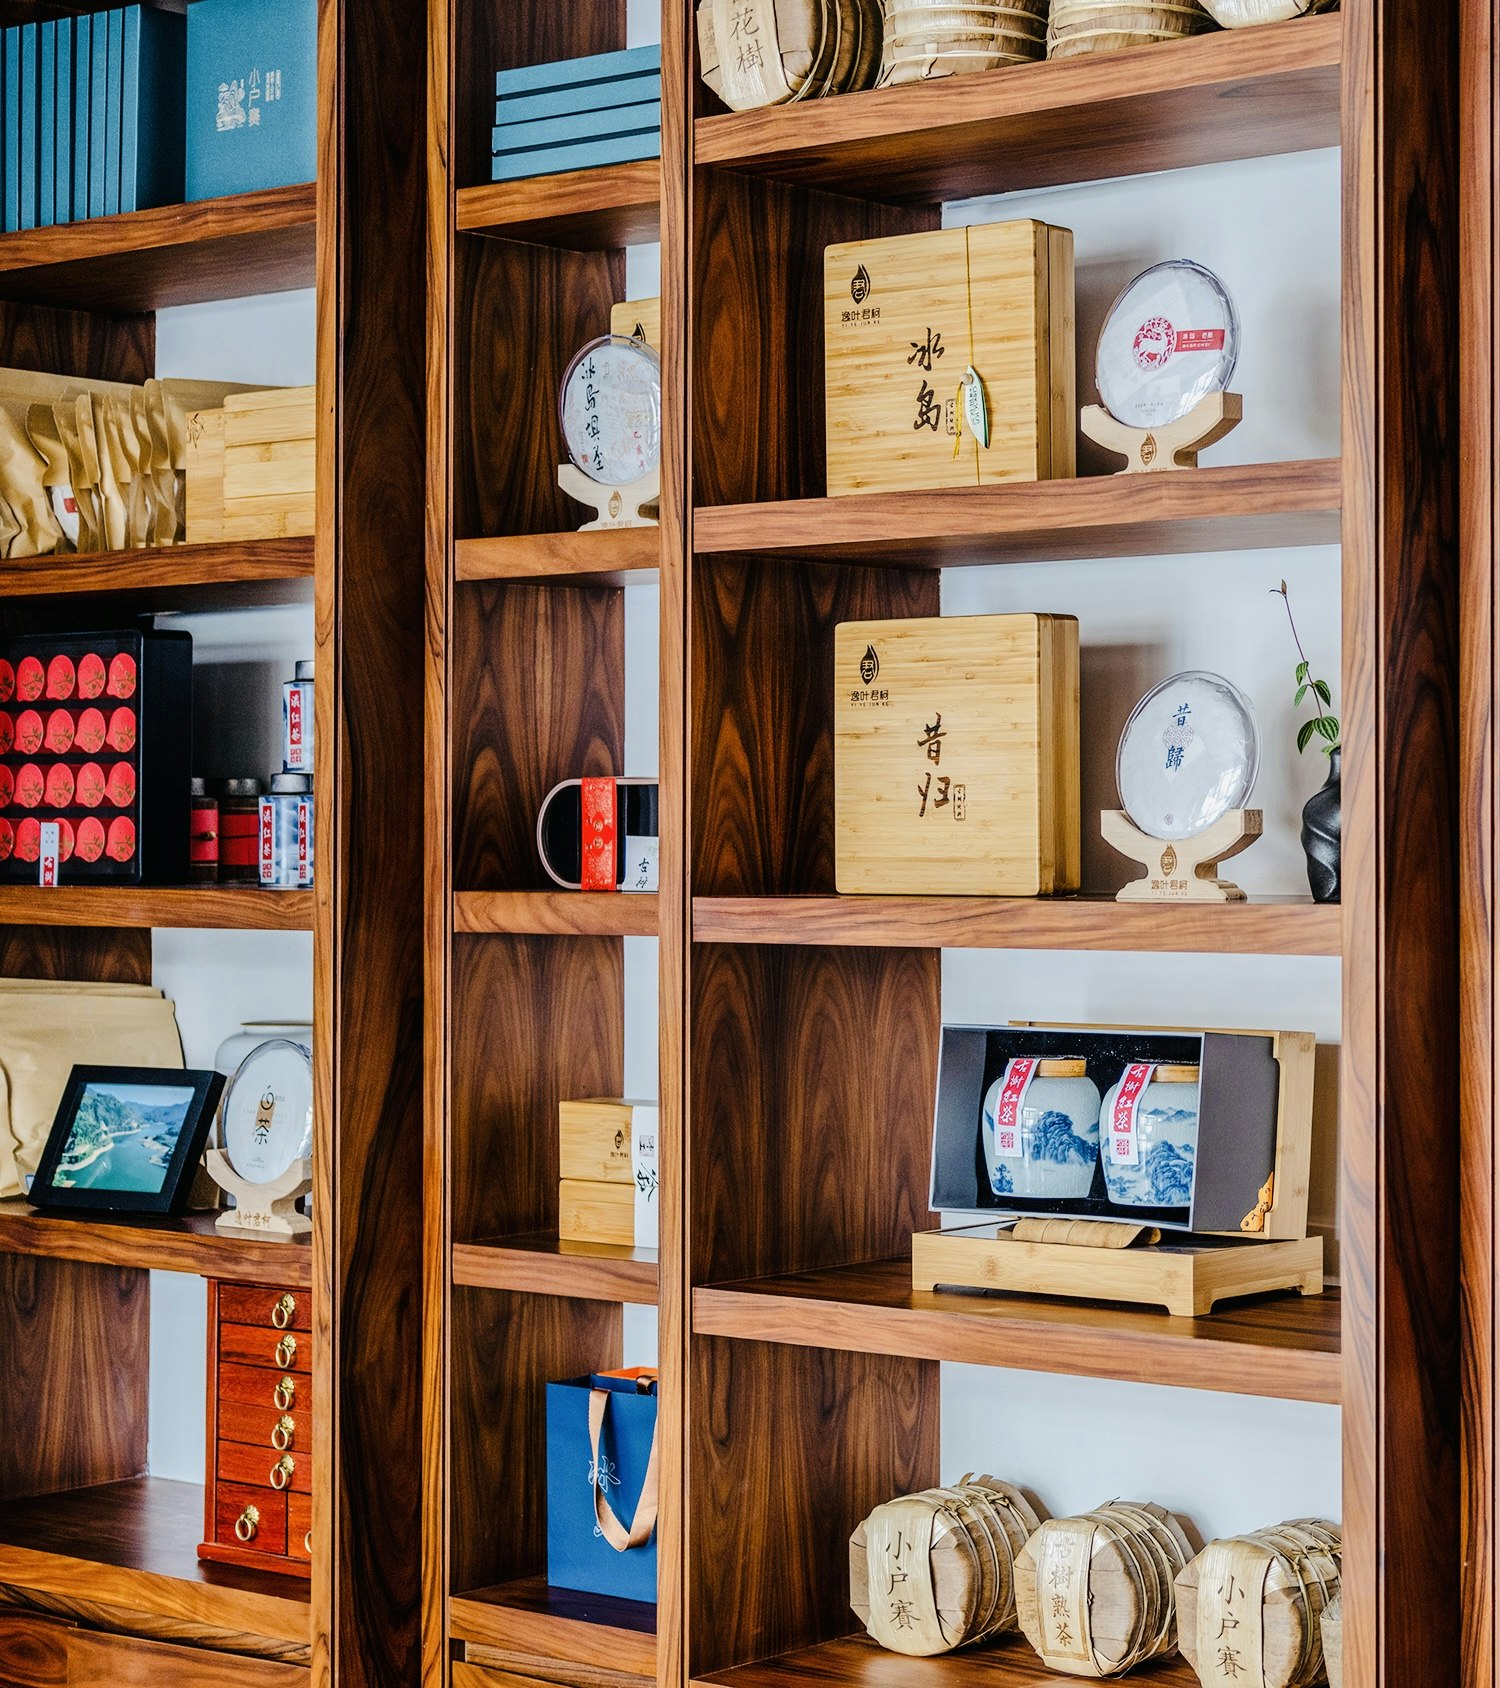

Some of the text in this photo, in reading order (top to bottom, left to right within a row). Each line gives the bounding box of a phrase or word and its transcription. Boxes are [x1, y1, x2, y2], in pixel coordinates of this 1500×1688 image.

[730, 0, 764, 74] 花樹
[917, 712, 951, 817] 昔归
[1165, 702, 1191, 772] 昔歸
[886, 1531, 921, 1630] 小户賽
[1216, 1575, 1247, 1679] 小户賽
